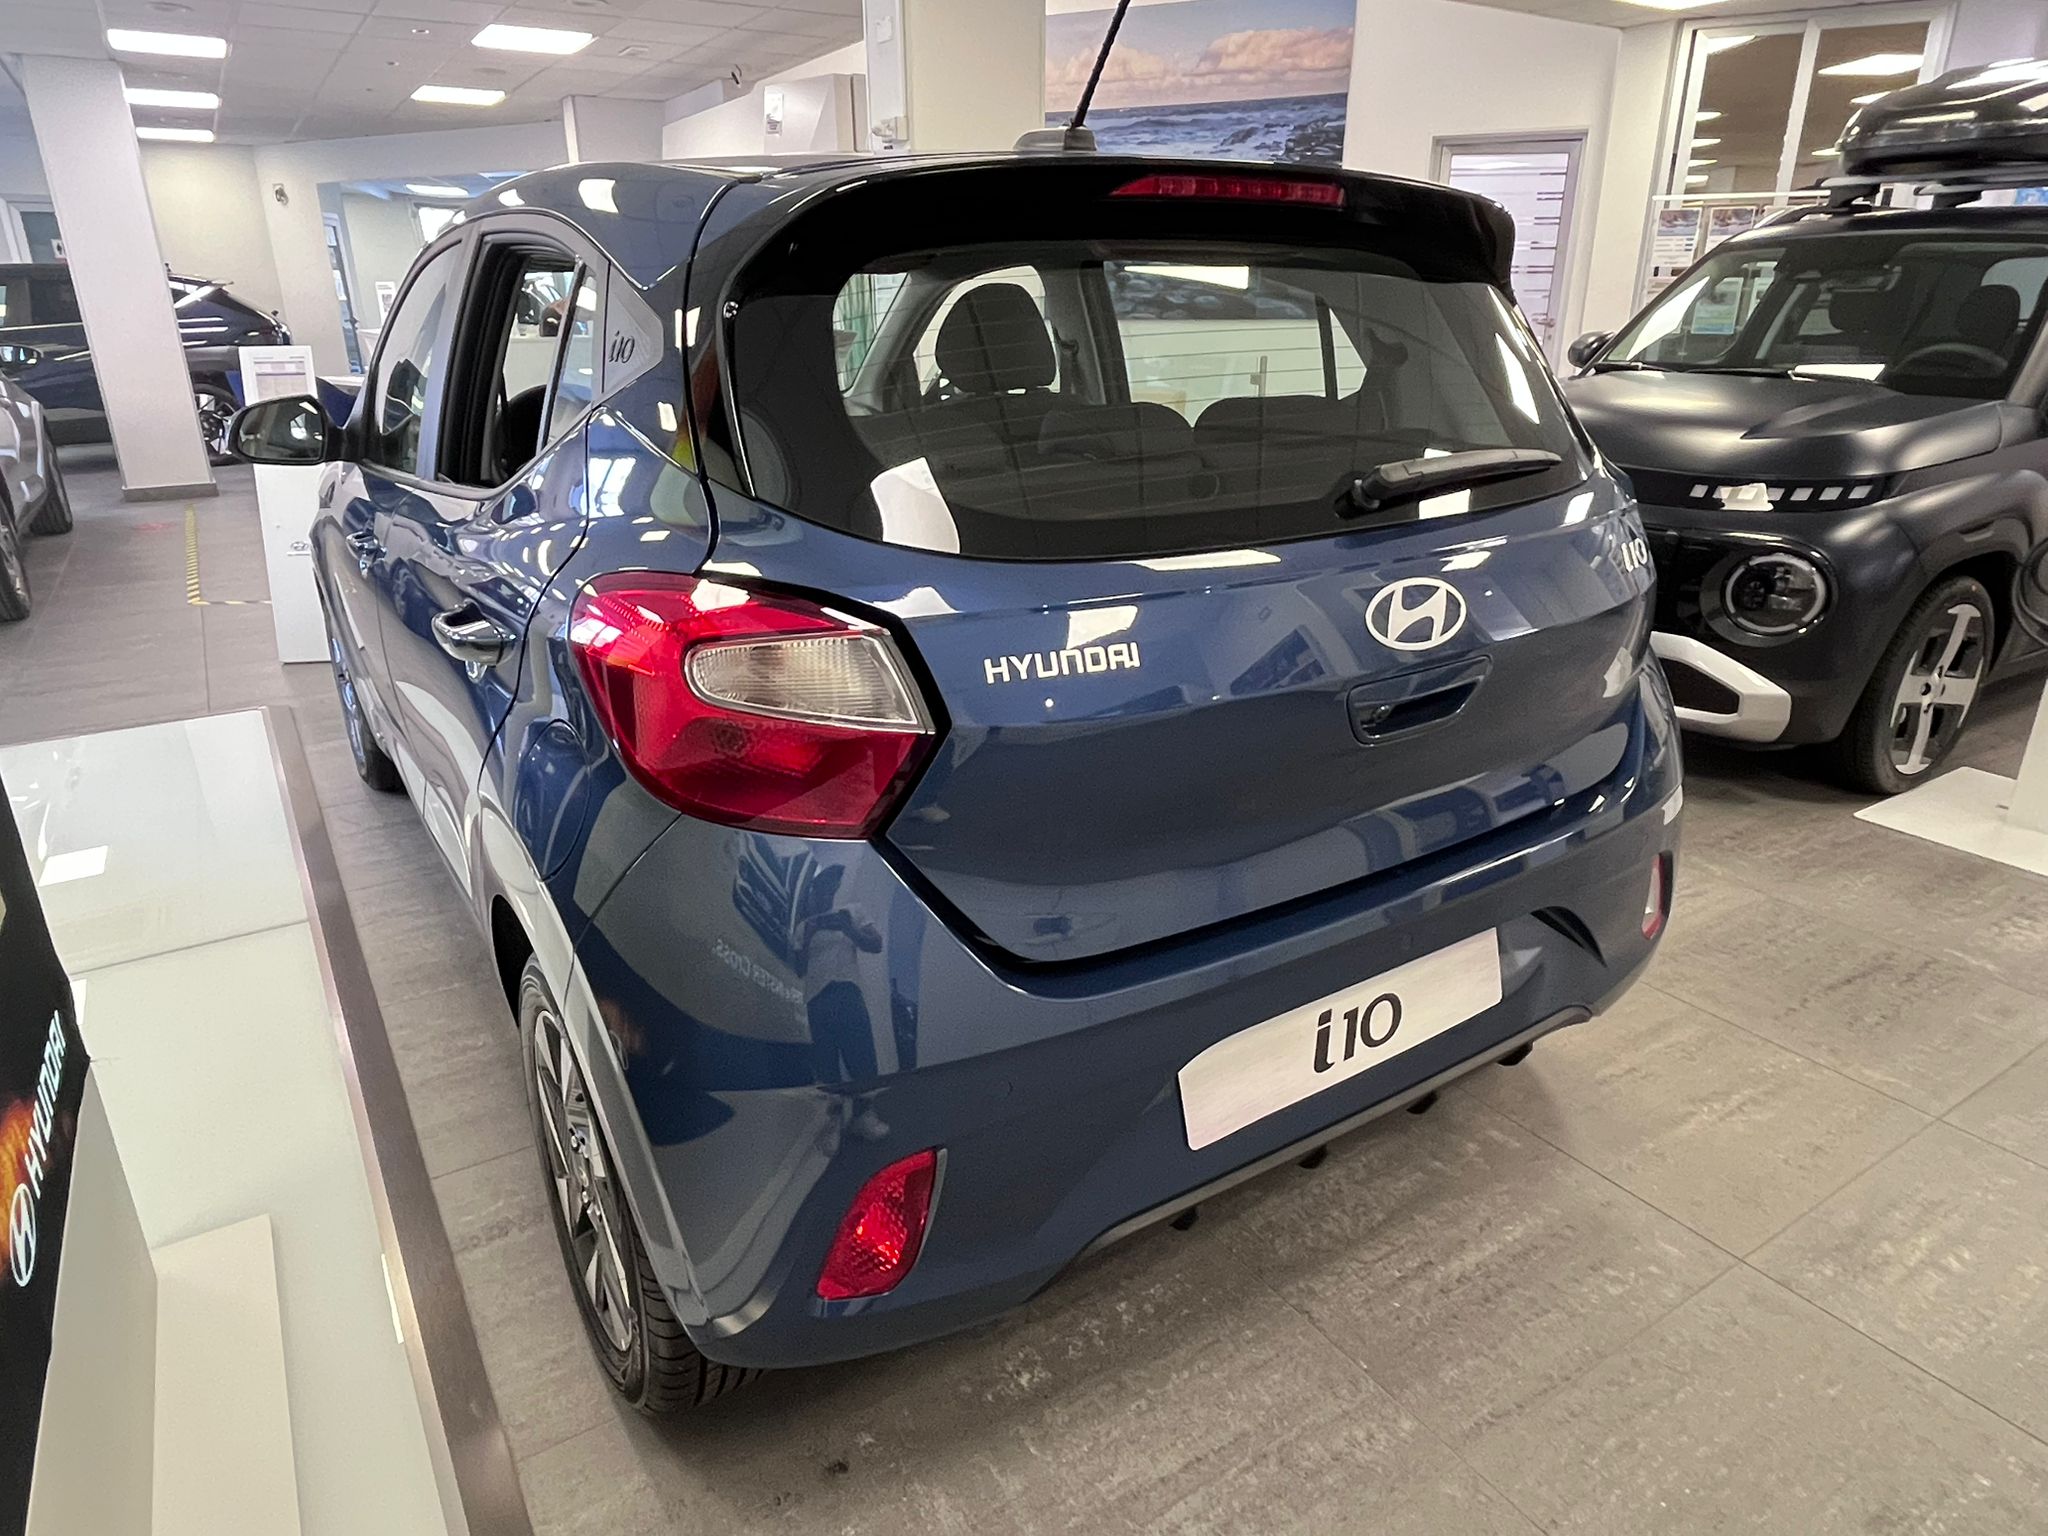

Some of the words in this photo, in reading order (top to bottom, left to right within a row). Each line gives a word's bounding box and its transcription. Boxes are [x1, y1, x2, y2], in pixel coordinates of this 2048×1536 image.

[609, 330, 635, 363] i10
[983, 642, 1141, 684] HYUNDAI
[1313, 992, 1402, 1074] i10
[24, 1009, 67, 1200] HYUNDAI
